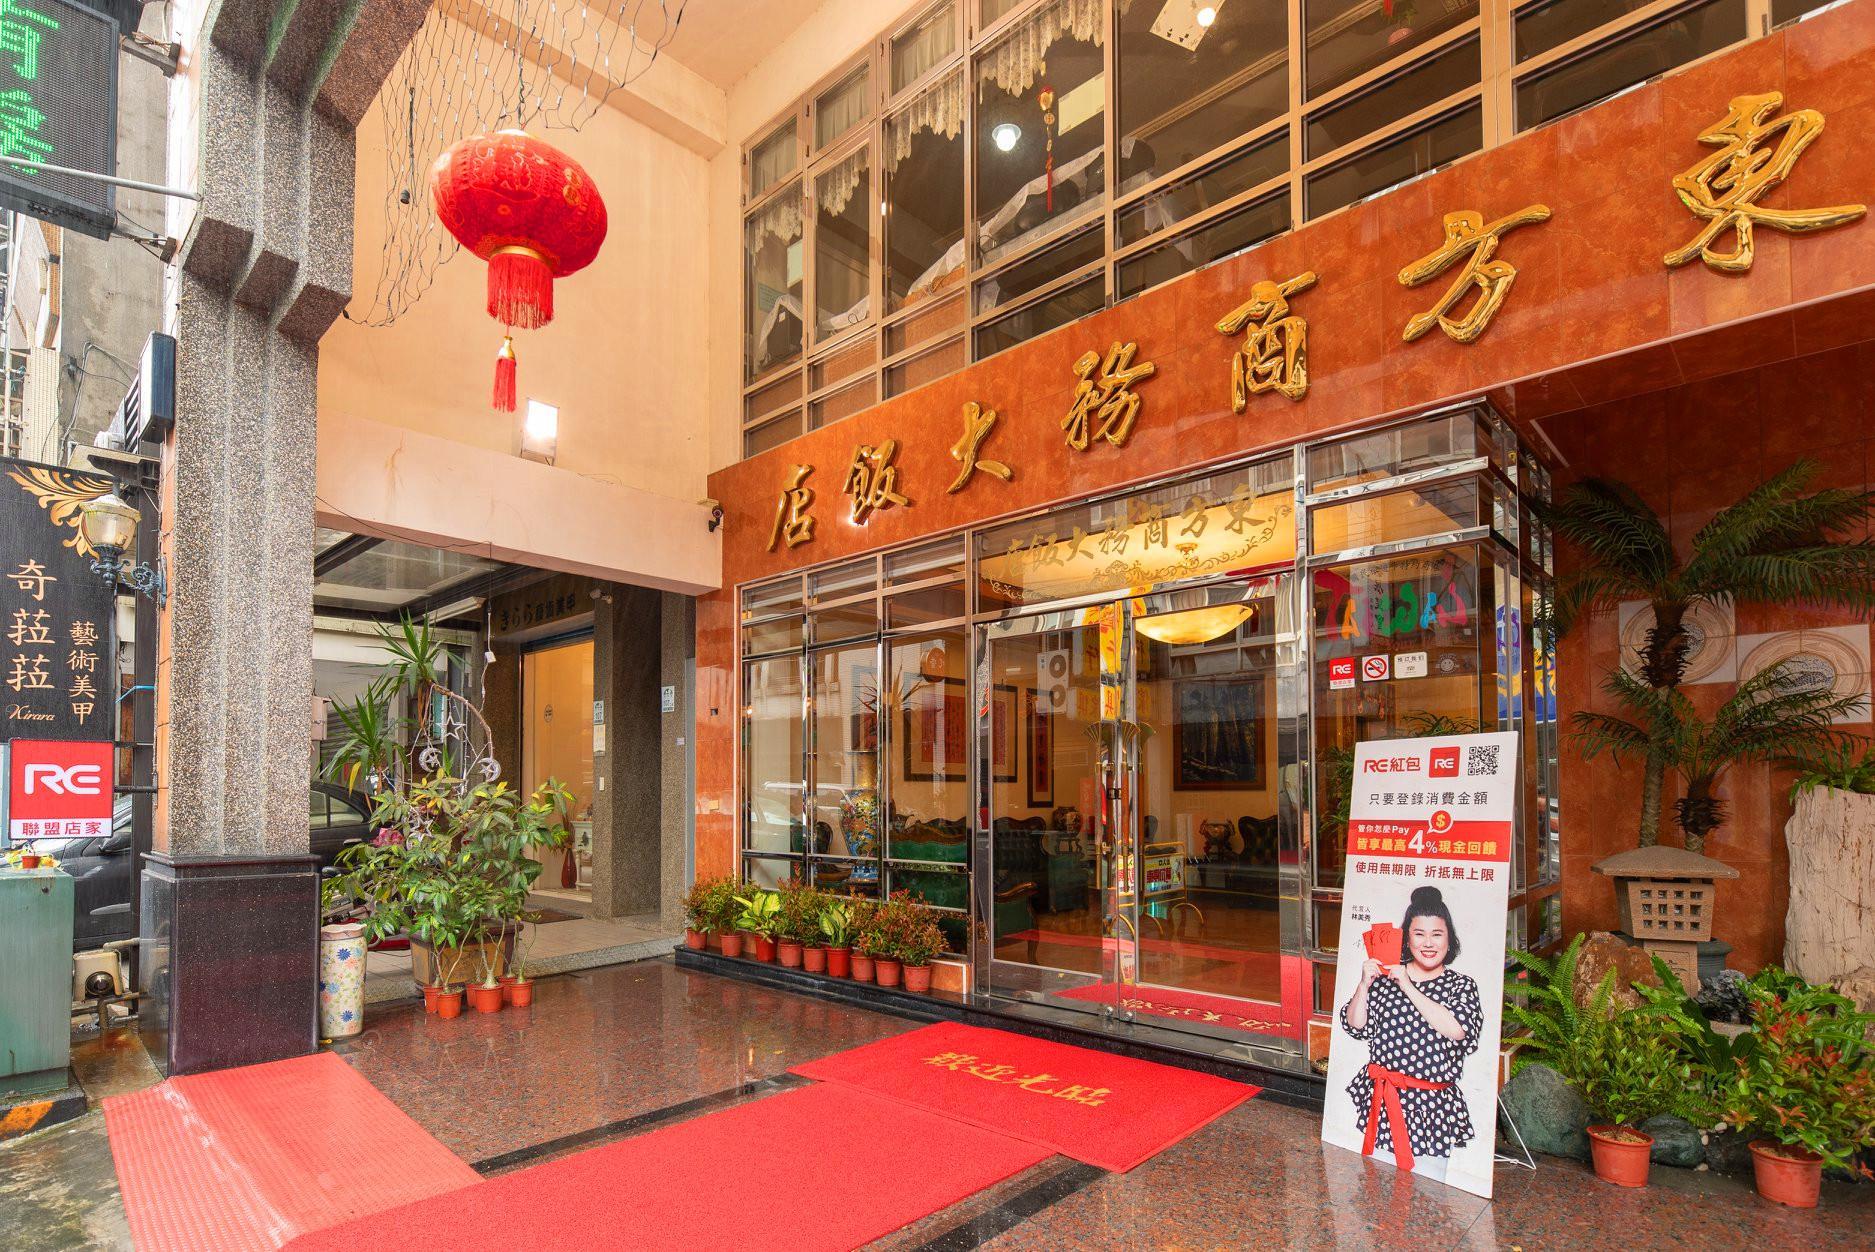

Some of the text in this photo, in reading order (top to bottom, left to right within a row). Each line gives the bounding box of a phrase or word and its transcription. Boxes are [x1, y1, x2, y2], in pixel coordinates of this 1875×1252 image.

[6, 559, 57, 693] 奇菈菈
[66, 620, 100, 726] 藝術美甲
[1434, 757, 1455, 769] RE
[24, 763, 101, 796] RE
[1369, 791, 1488, 806] 只要登錄消費金額
[22, 821, 102, 837] 聯盟店家
[1355, 861, 1494, 882] 使用無期限 折抵無上限
